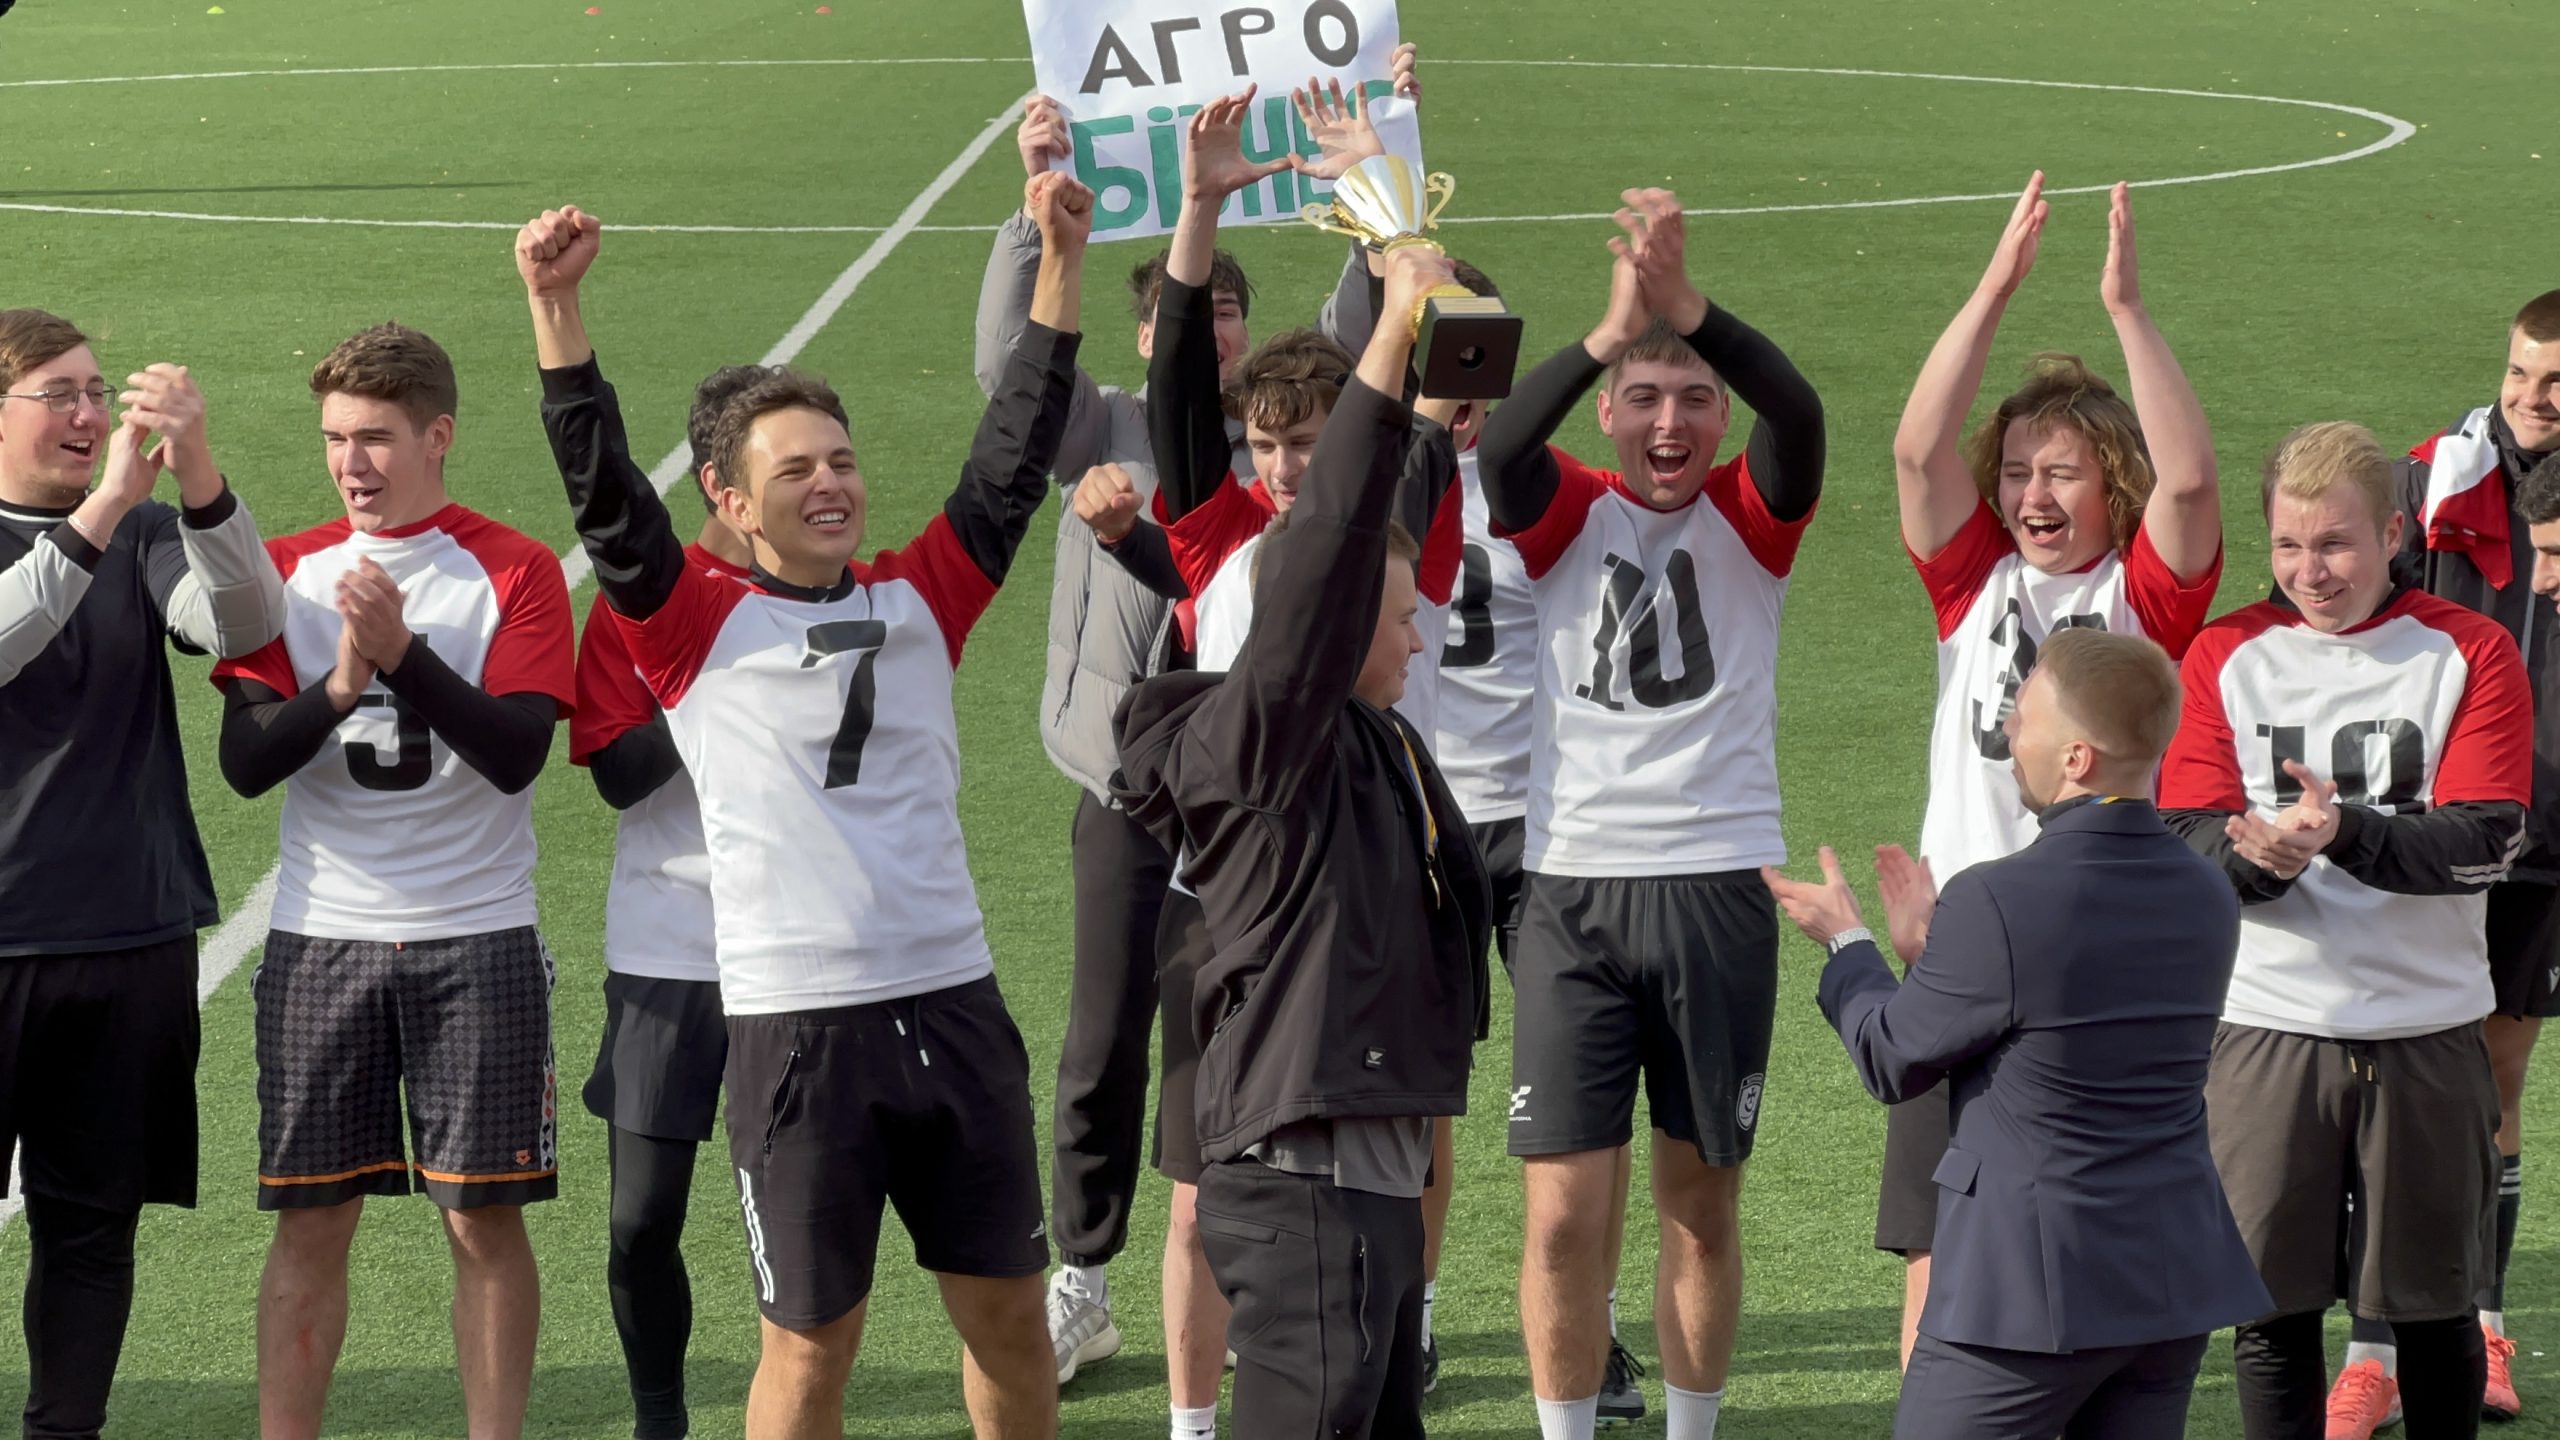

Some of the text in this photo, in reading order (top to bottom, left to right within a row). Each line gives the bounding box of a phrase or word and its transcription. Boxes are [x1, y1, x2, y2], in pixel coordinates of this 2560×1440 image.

[1079, 0, 1359, 94] АГРО
[1575, 548, 1716, 712] 10
[800, 619, 887, 790] 7
[2256, 717, 2426, 814] 10
